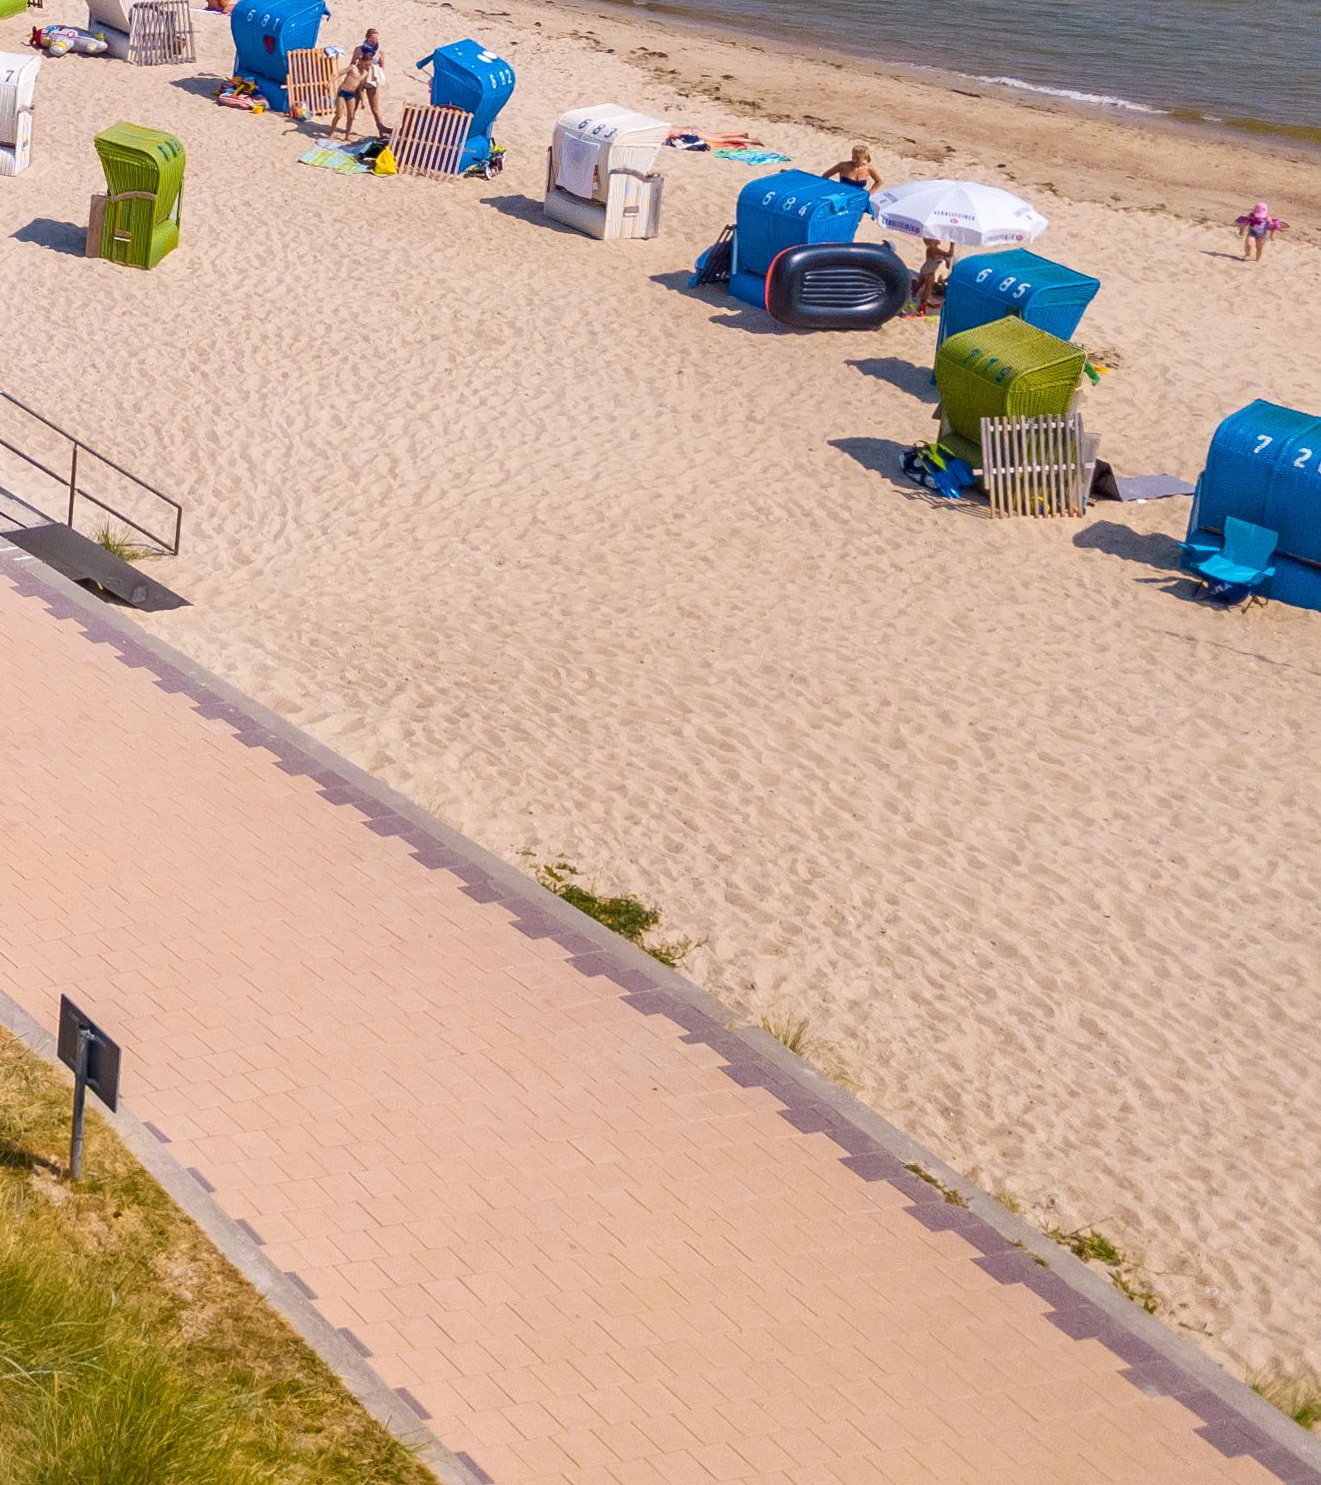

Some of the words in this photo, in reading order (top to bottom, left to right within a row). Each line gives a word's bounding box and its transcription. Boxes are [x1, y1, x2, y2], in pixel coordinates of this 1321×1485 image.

[246, 9, 280, 31] 681
[975, 267, 1031, 299] 685
[1253, 434, 1321, 474] 72
